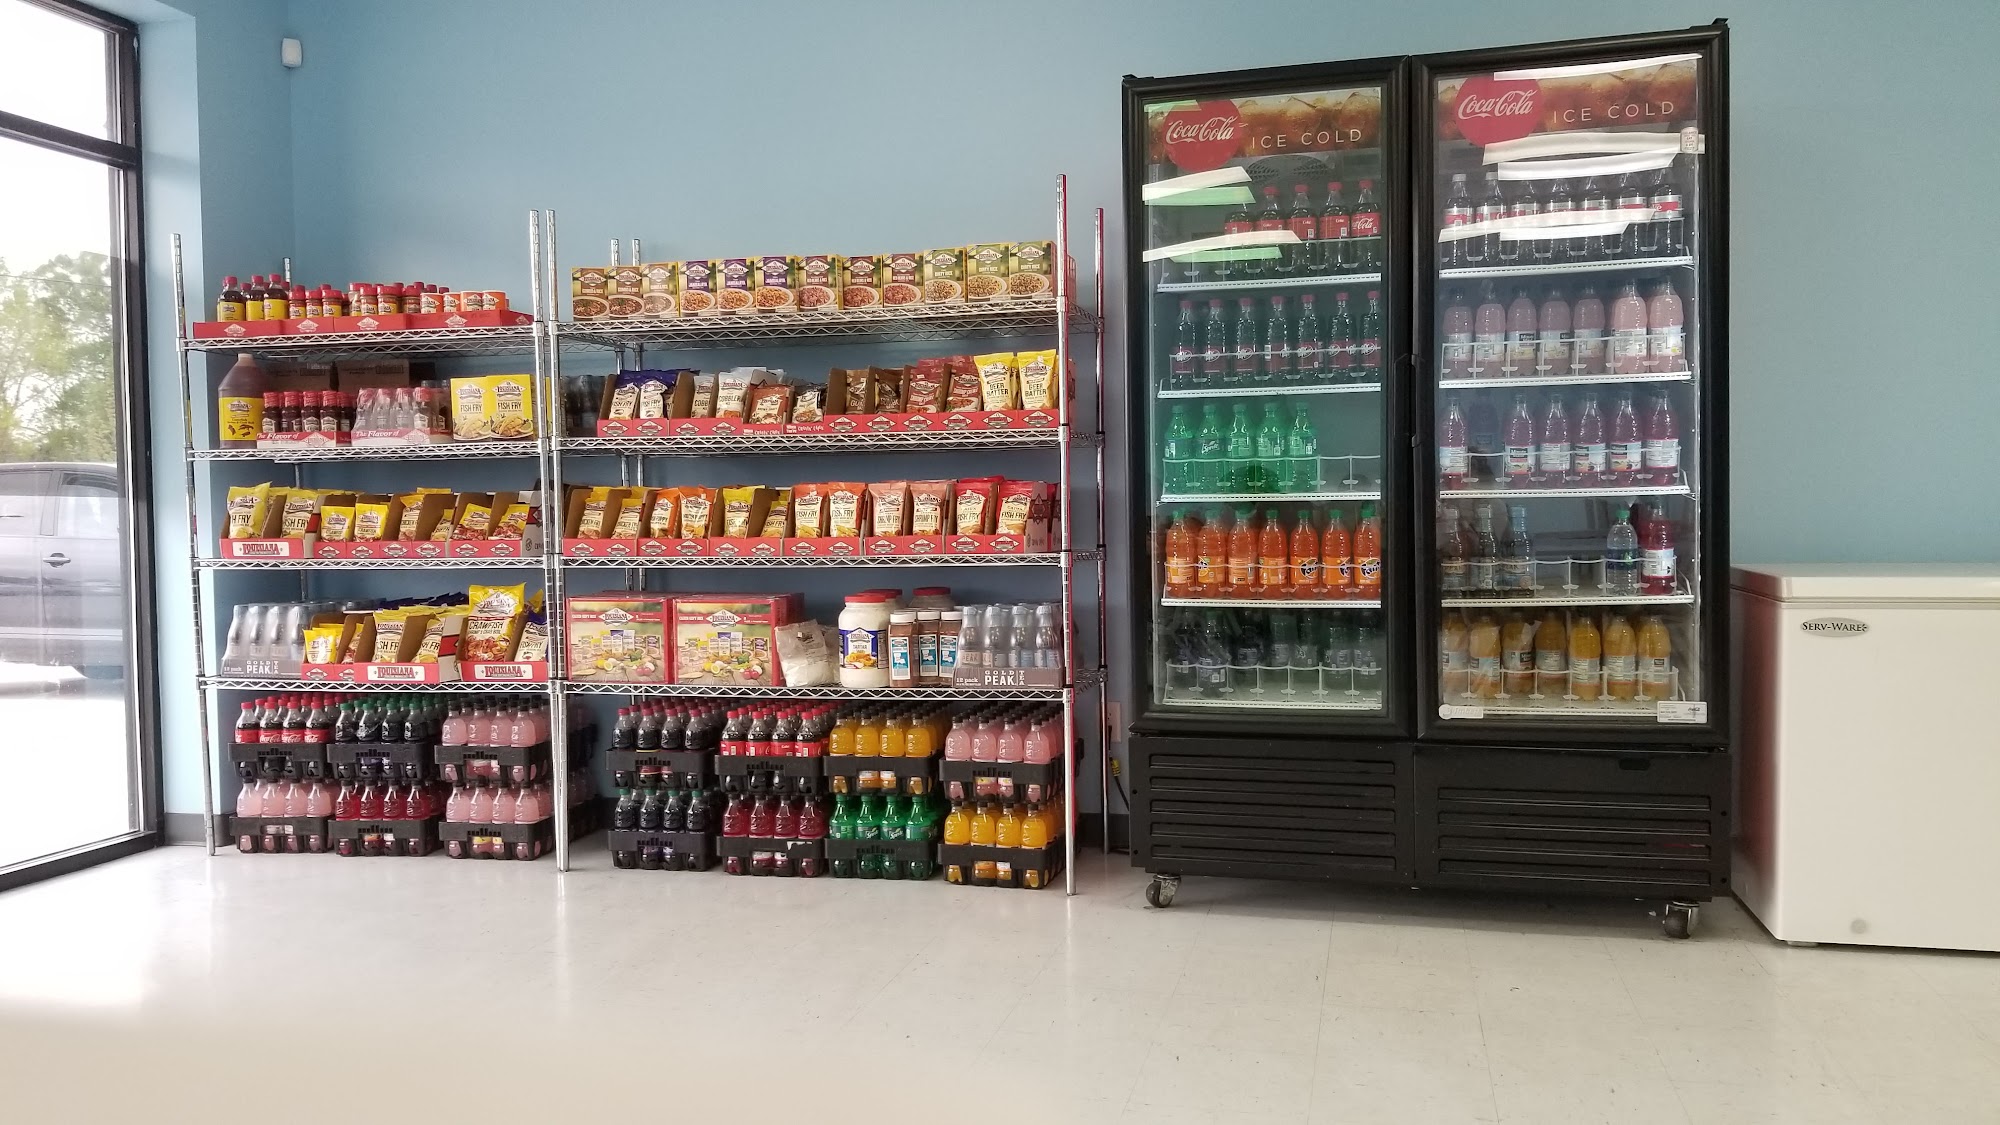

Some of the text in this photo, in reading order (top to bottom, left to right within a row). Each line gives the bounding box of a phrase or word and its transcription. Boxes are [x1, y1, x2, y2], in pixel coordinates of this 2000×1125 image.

[1458, 89, 1537, 120] Coca-Cola
[1553, 101, 1675, 124] ICE COLD
[1166, 115, 1238, 144] Coca-Cola
[1252, 128, 1362, 149] ICE COLD
[460, 404, 471, 412] FISH
[498, 402, 510, 410] FISH
[242, 544, 280, 555] LOUISIANA
[469, 621, 504, 629] CRAWFISH
[247, 665, 272, 674] PEAK
[377, 667, 415, 678] LOUISIANA
[484, 666, 523, 677] LOUISIANA
[984, 676, 1015, 685] PEAK
